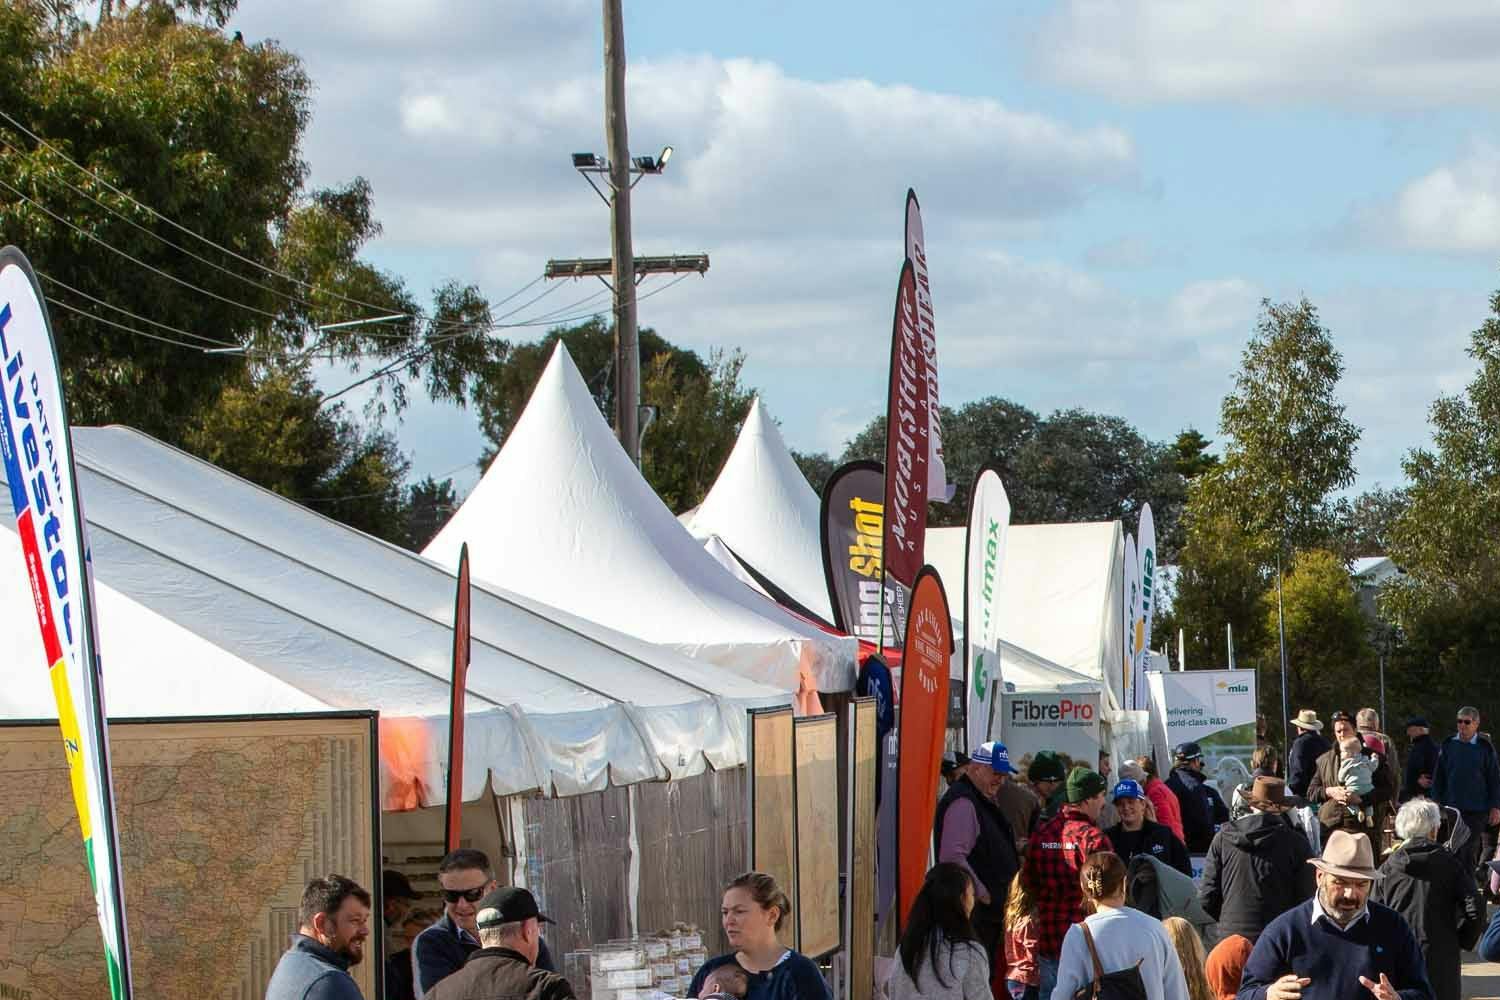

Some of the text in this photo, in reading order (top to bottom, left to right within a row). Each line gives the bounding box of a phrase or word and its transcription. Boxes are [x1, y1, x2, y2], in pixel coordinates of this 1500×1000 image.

[0, 303, 75, 664] Livesto
[1228, 684, 1249, 693] mla
[1011, 700, 1093, 720] FibrePro
[1210, 718, 1228, 726] R&D
